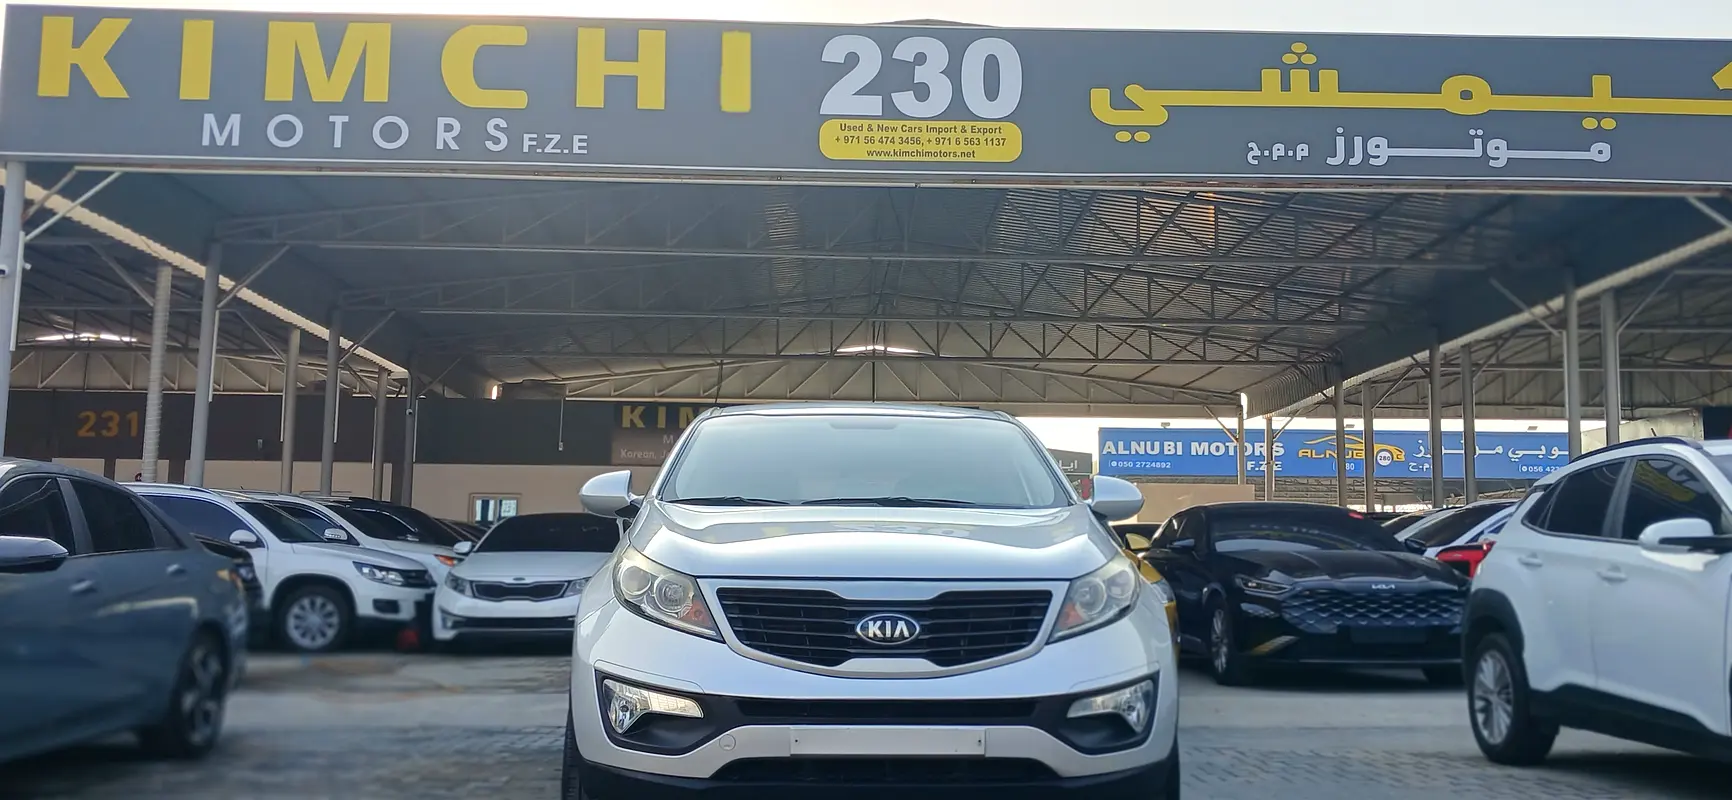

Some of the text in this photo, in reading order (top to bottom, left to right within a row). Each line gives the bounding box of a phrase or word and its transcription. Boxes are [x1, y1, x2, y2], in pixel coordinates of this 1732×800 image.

[37, 16, 752, 113] KIMCHI
[819, 34, 1023, 119] 230
[201, 113, 588, 154] MOTORS F.Z.E
[840, 123, 1002, 136] Used & New Cars Import & Export
[843, 135, 860, 144] 971
[863, 136, 875, 145] 56
[878, 136, 895, 145] 474
[898, 136, 924, 147] 3456,
[935, 137, 951, 146] 971
[955, 137, 961, 146] 6
[963, 137, 980, 146] 563
[984, 137, 1006, 147] 1137
[866, 149, 975, 158] www.kimchimotors.net
[1325, 126, 1612, 168] موتورز
[77, 410, 139, 437] 231
[622, 405, 705, 429] KIM
[866, 620, 910, 638] KIA
